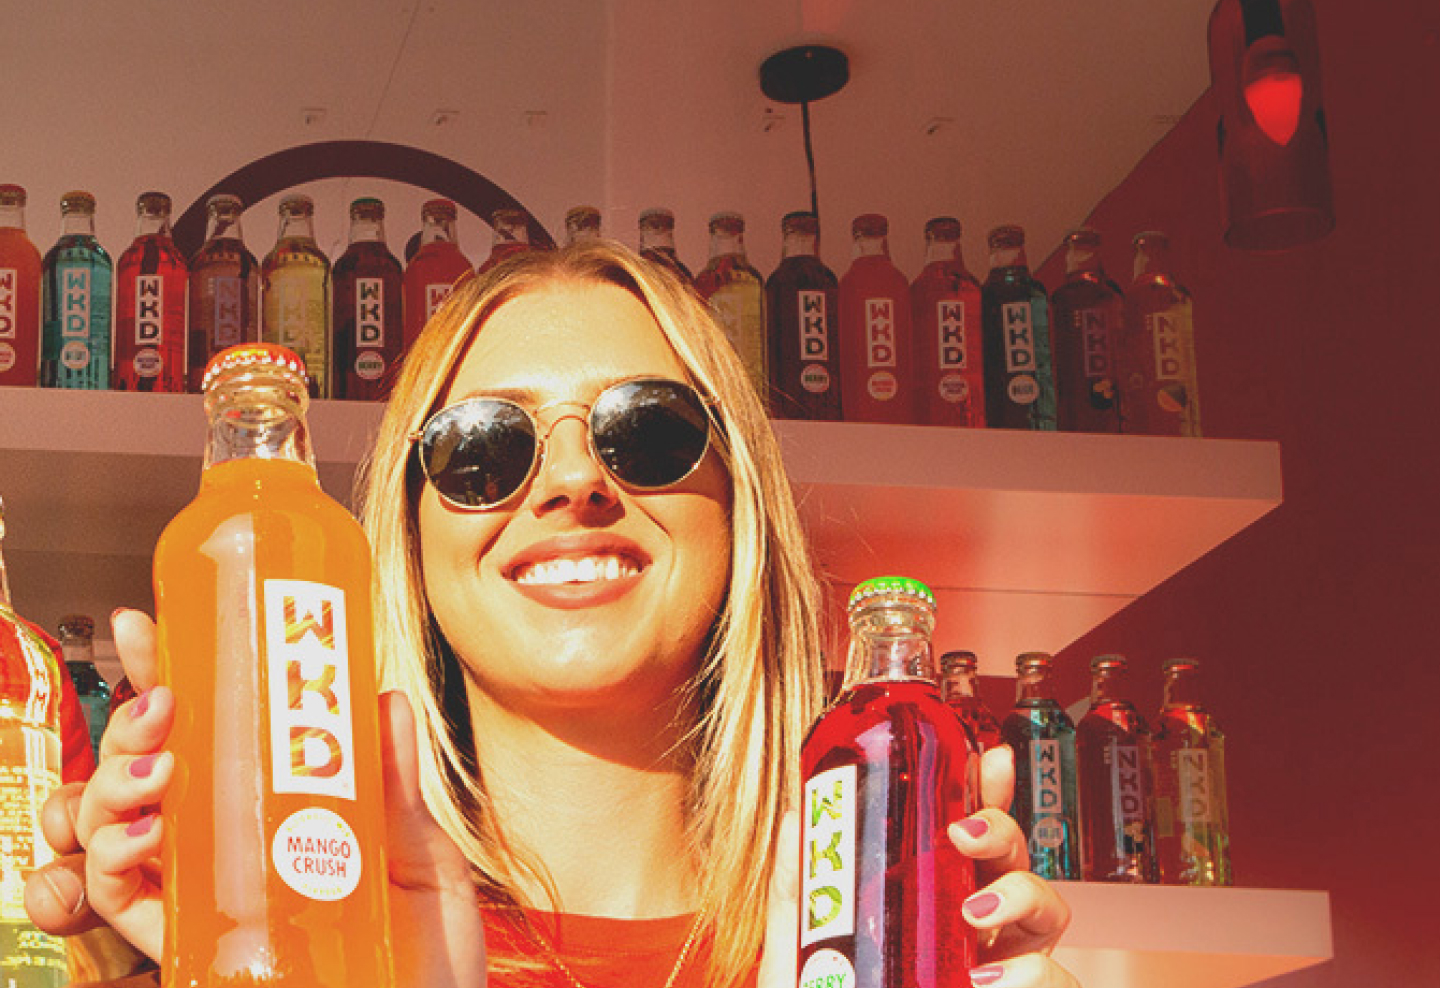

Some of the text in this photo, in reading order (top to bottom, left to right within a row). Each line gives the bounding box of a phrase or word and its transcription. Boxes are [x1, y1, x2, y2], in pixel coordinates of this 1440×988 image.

[67, 272, 87, 332] WKD
[140, 279, 159, 338] WKD
[361, 282, 380, 341] WKD
[804, 294, 825, 355] WKD
[870, 303, 892, 362] WKD
[942, 305, 963, 364] WKD
[1008, 307, 1030, 366] WKD
[282, 595, 343, 778] WKD
[1034, 744, 1057, 809] WKD
[287, 836, 351, 859] MANGO
[293, 856, 347, 878] CRUSH
[809, 780, 843, 931] WKD
